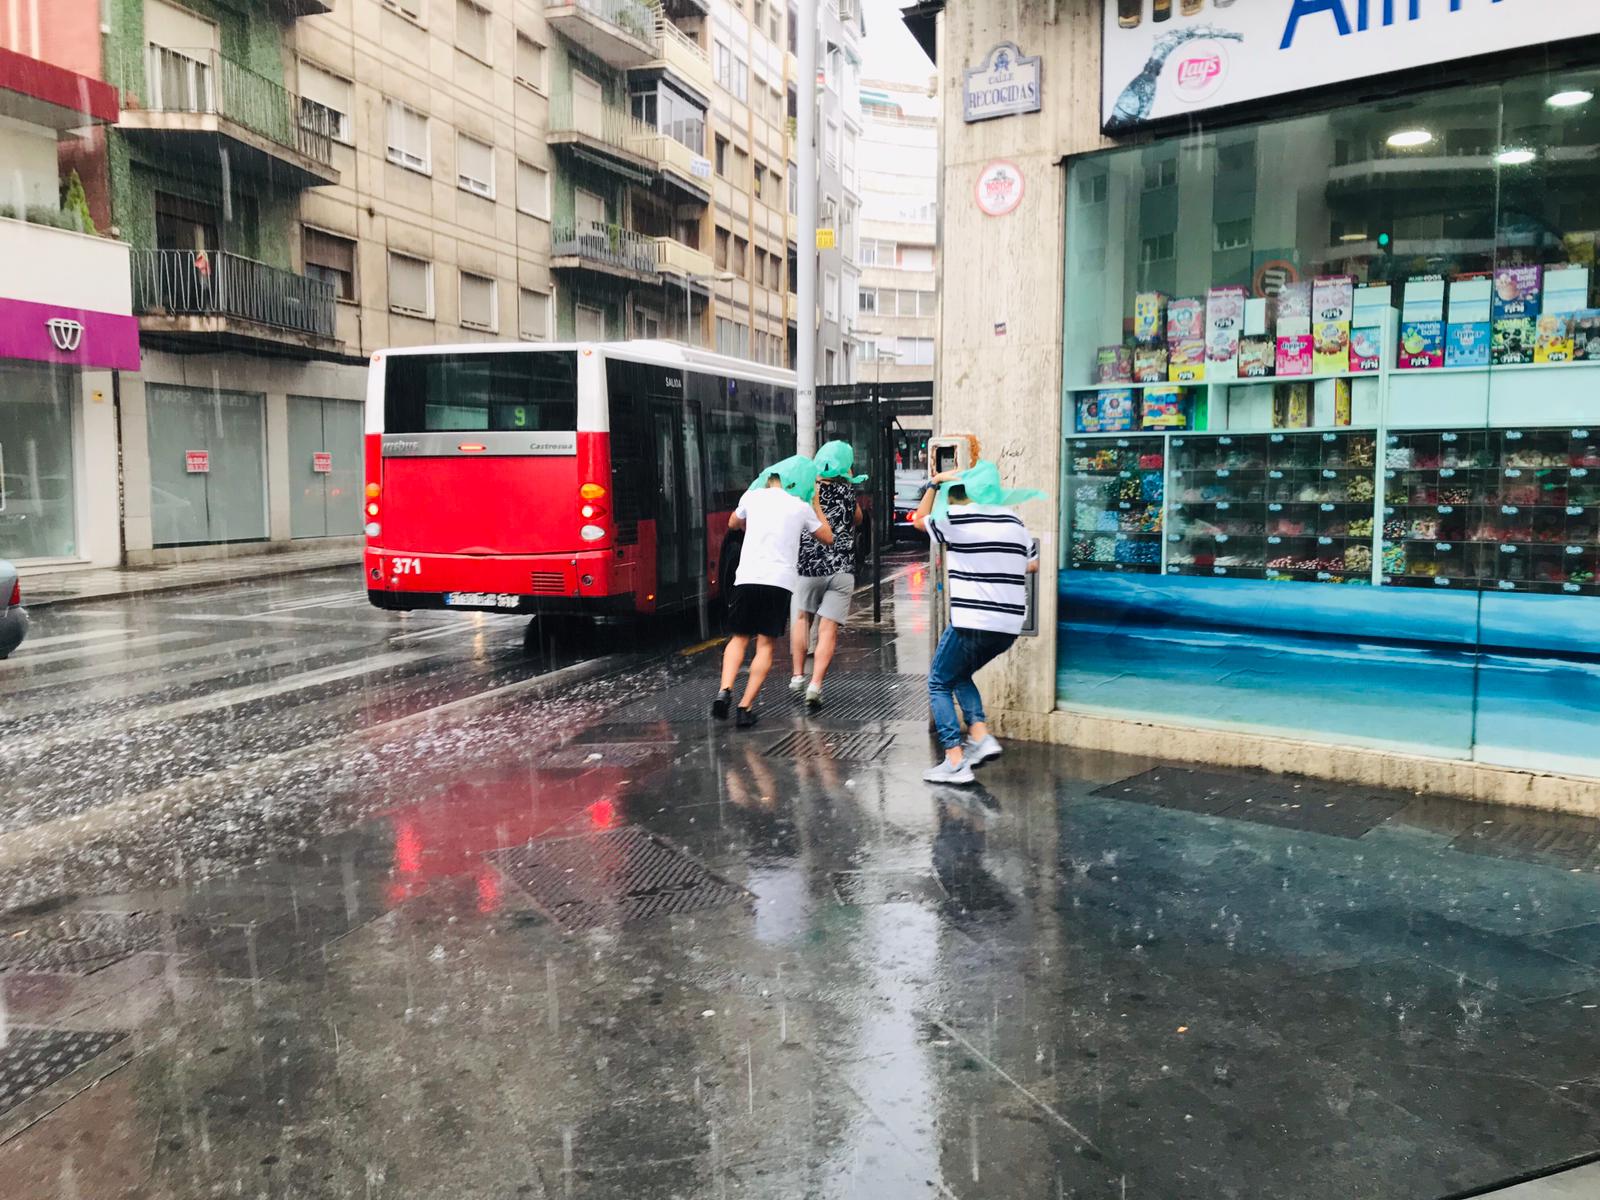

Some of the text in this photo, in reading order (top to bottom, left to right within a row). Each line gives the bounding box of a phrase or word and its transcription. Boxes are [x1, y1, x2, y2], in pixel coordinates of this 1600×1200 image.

[988, 73, 1014, 85] CALLE
[969, 82, 1034, 108] RECOGIDAS
[514, 405, 526, 426] 9
[530, 443, 574, 451] Castrosua
[391, 556, 422, 575] 371
